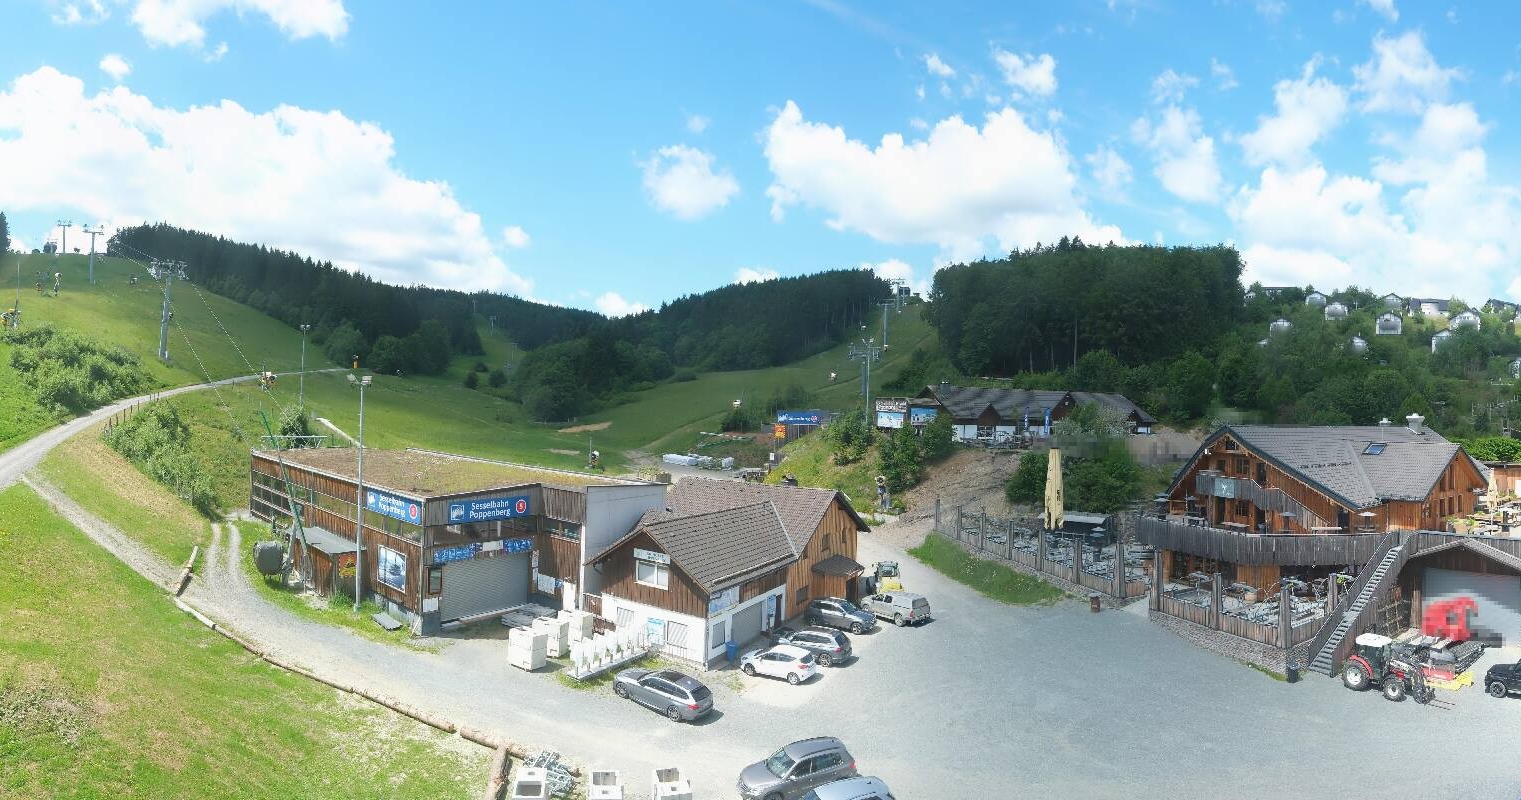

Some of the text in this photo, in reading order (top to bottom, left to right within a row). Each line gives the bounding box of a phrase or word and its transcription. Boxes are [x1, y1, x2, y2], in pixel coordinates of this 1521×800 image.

[379, 493, 405, 508] Sesselbahn
[471, 500, 509, 511] Sesselbahn
[378, 501, 406, 518] Poppenberg
[469, 508, 511, 519] Poppenberg
